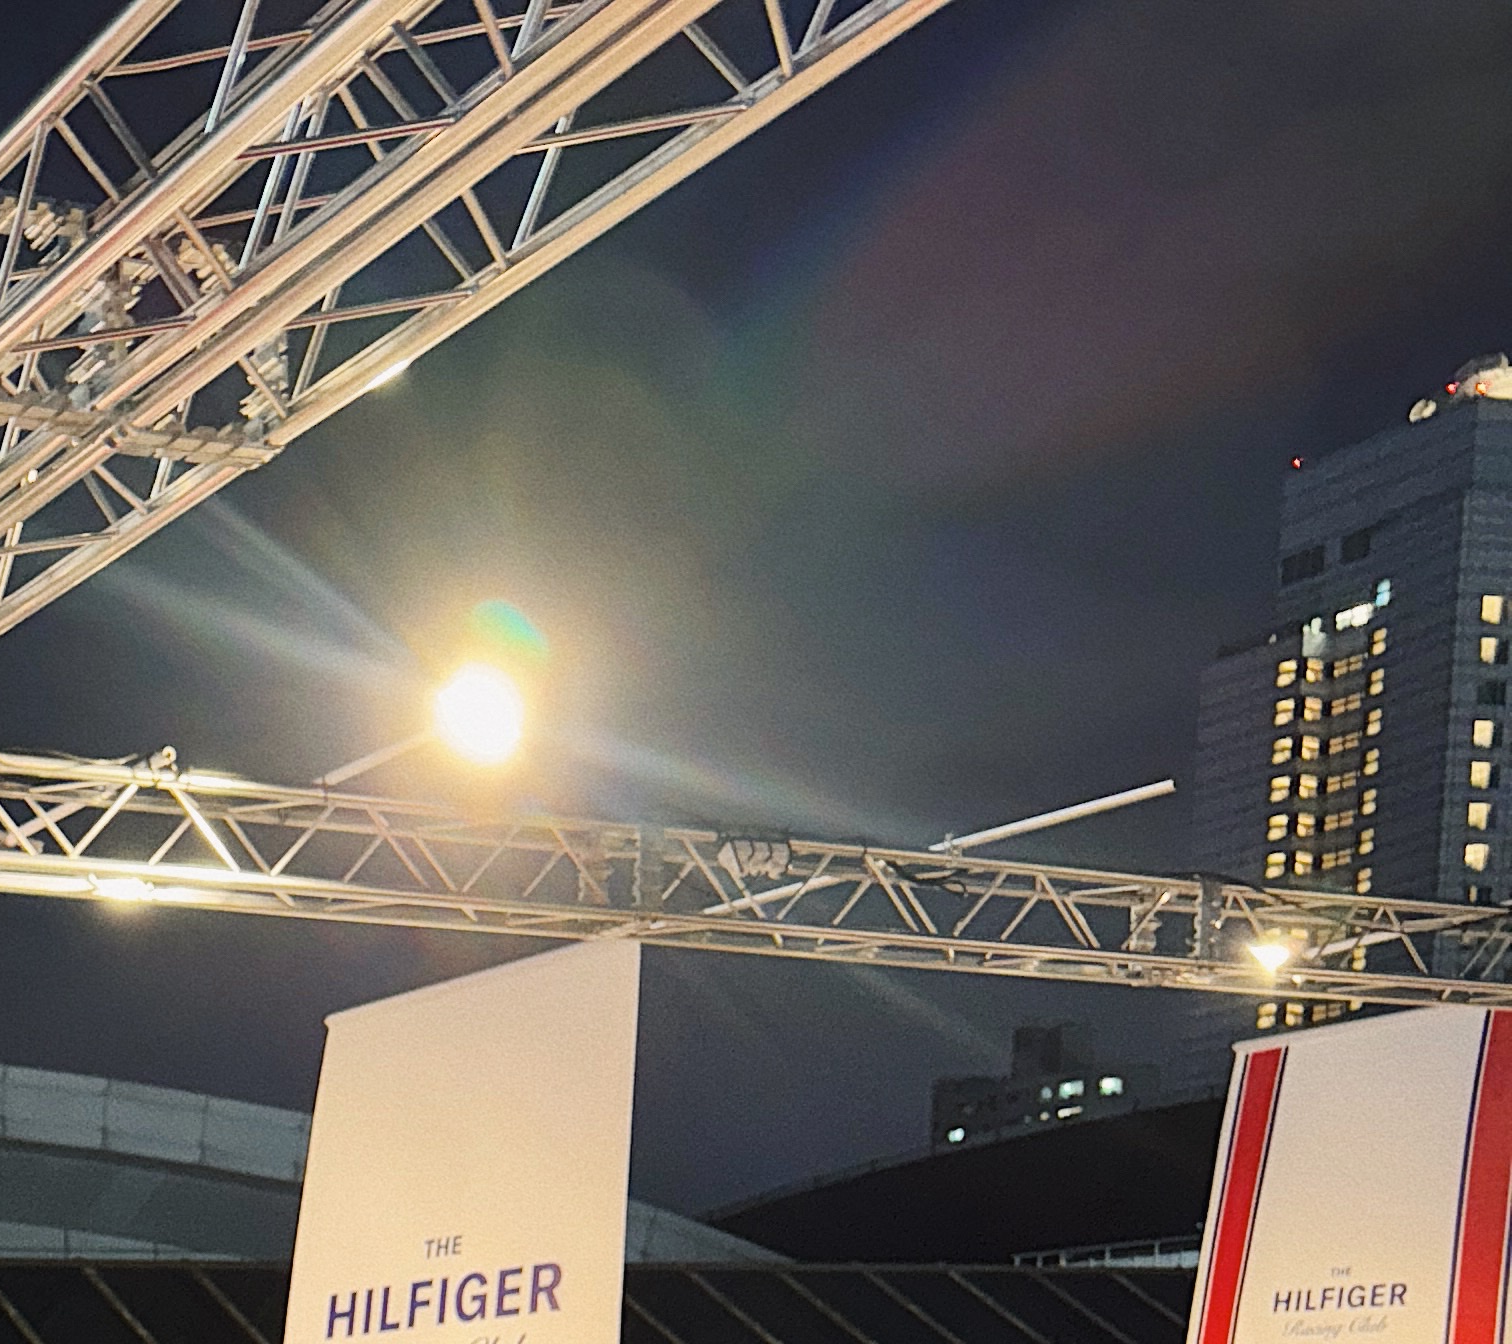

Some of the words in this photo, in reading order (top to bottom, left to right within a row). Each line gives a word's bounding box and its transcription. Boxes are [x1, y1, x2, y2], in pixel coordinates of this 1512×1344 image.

[425, 1236, 463, 1258] THE
[326, 1263, 562, 1339] HILFIGER
[1273, 1283, 1408, 1312] HILFIGER
